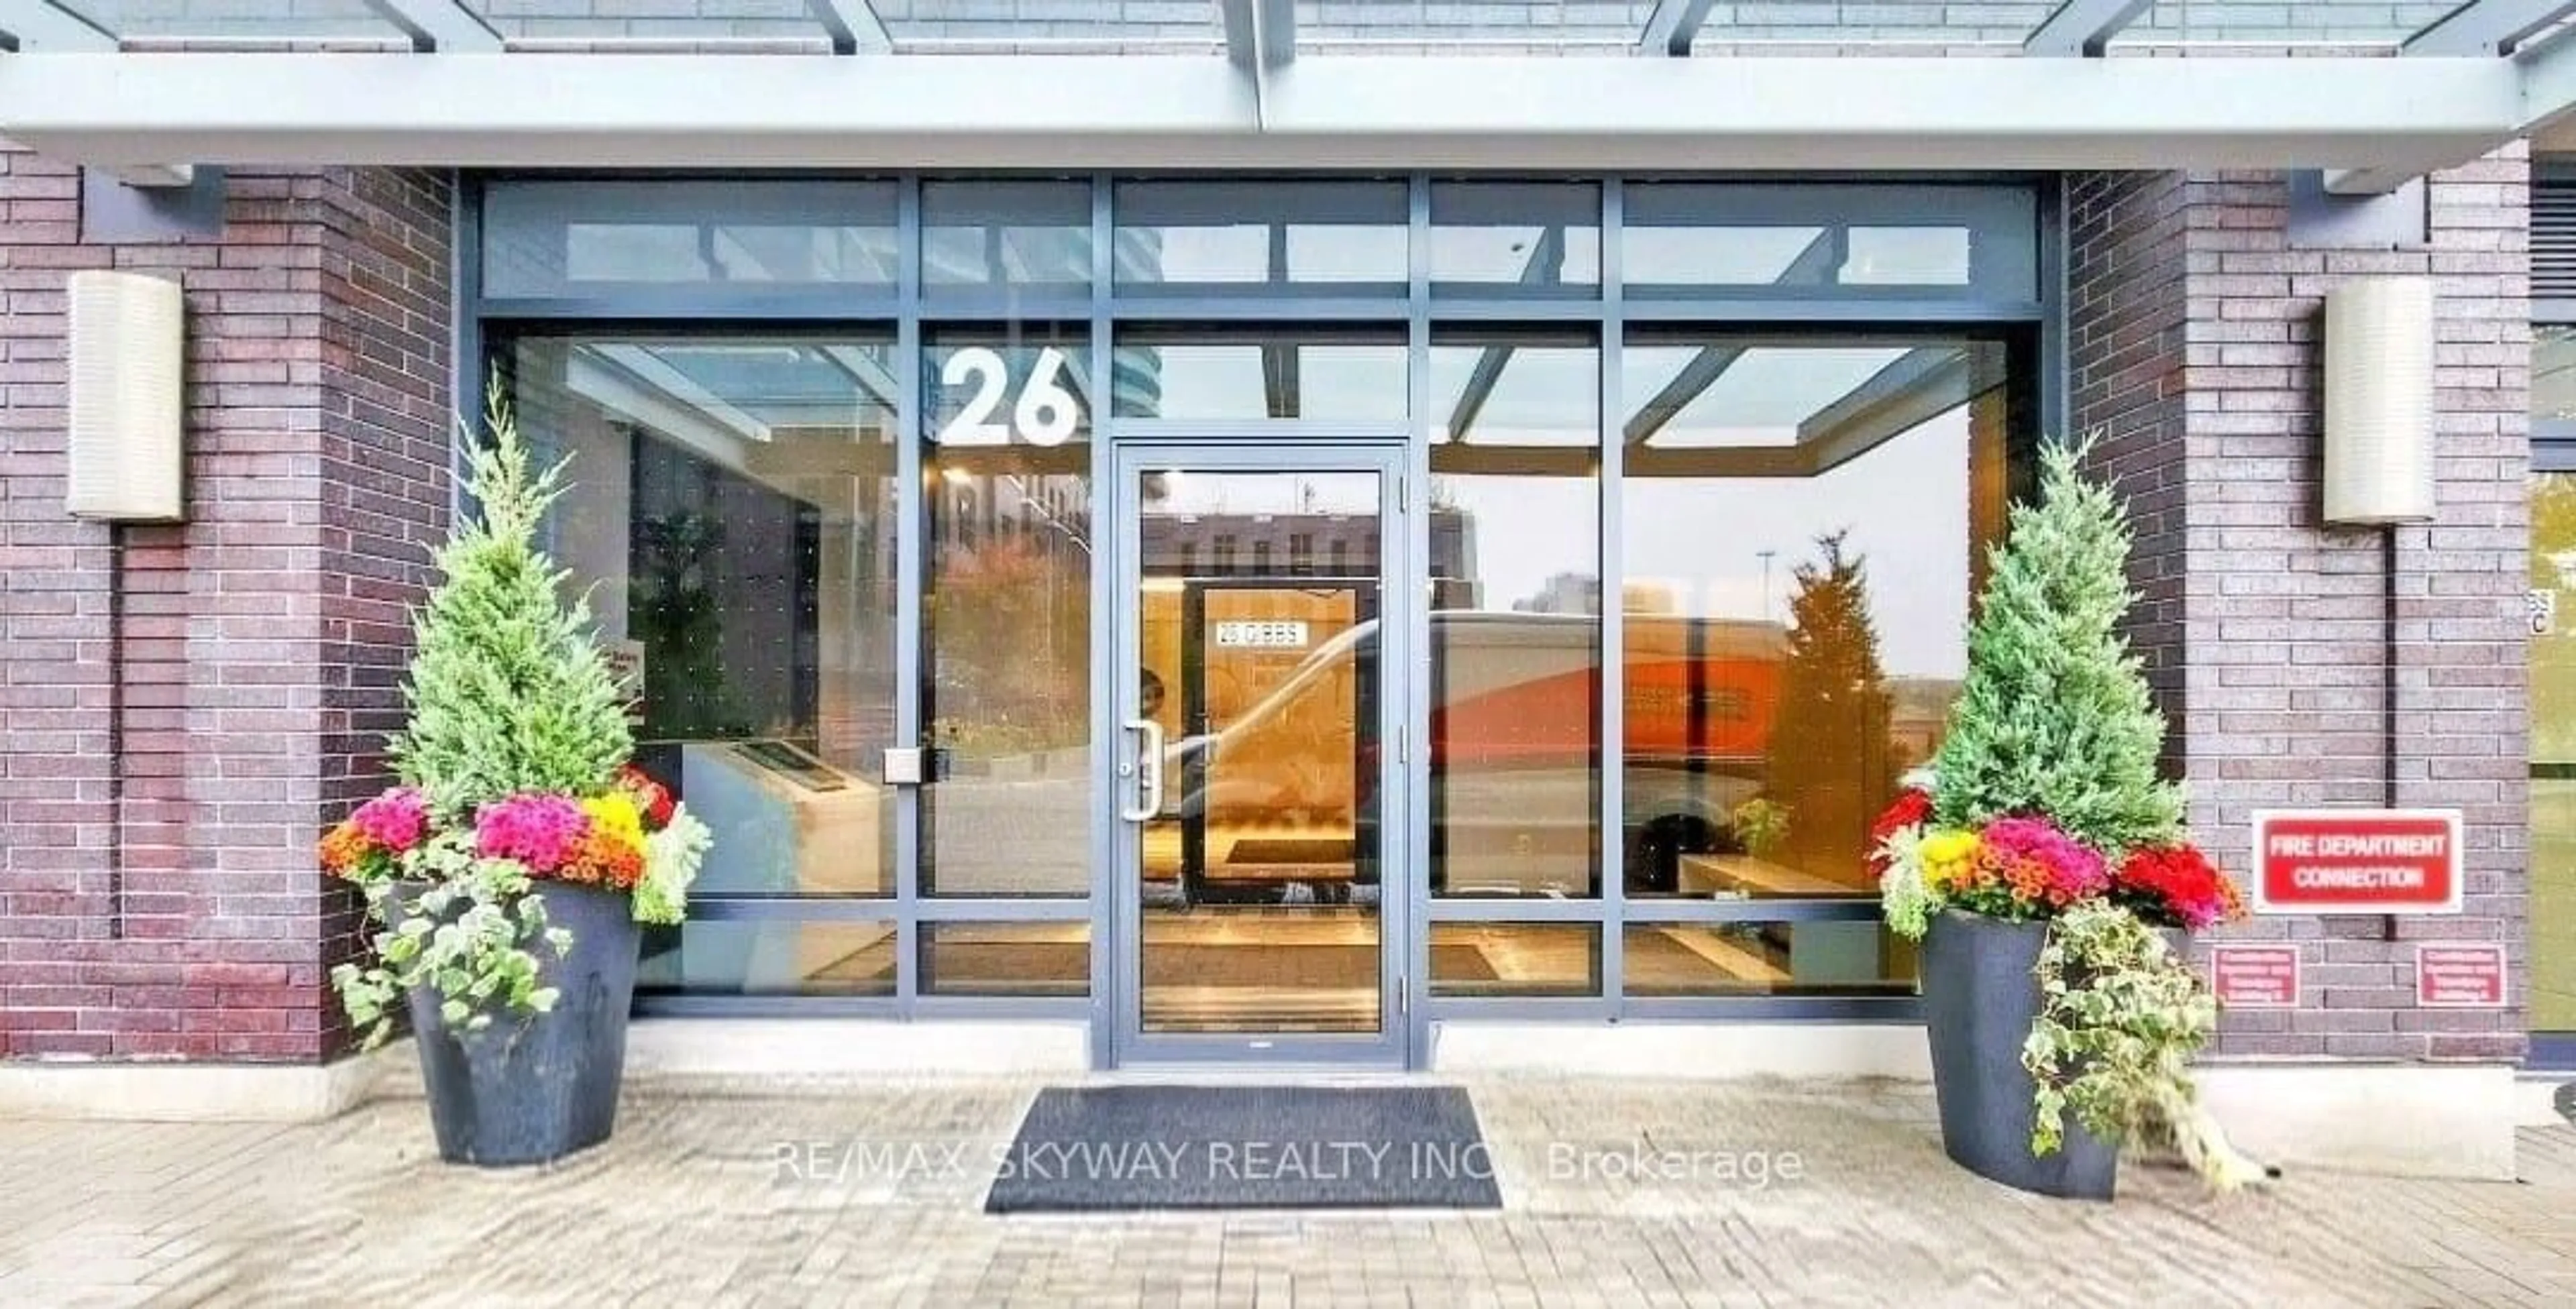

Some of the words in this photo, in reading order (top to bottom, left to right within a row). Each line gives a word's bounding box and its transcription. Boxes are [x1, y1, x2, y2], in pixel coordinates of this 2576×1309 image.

[941, 346, 1077, 447] 26
[1245, 624, 1296, 642] GBBS
[2270, 834, 2315, 856] FIRE
[2318, 834, 2445, 856] DEPARTMENT
[2293, 866, 2424, 889] CONNECTION
